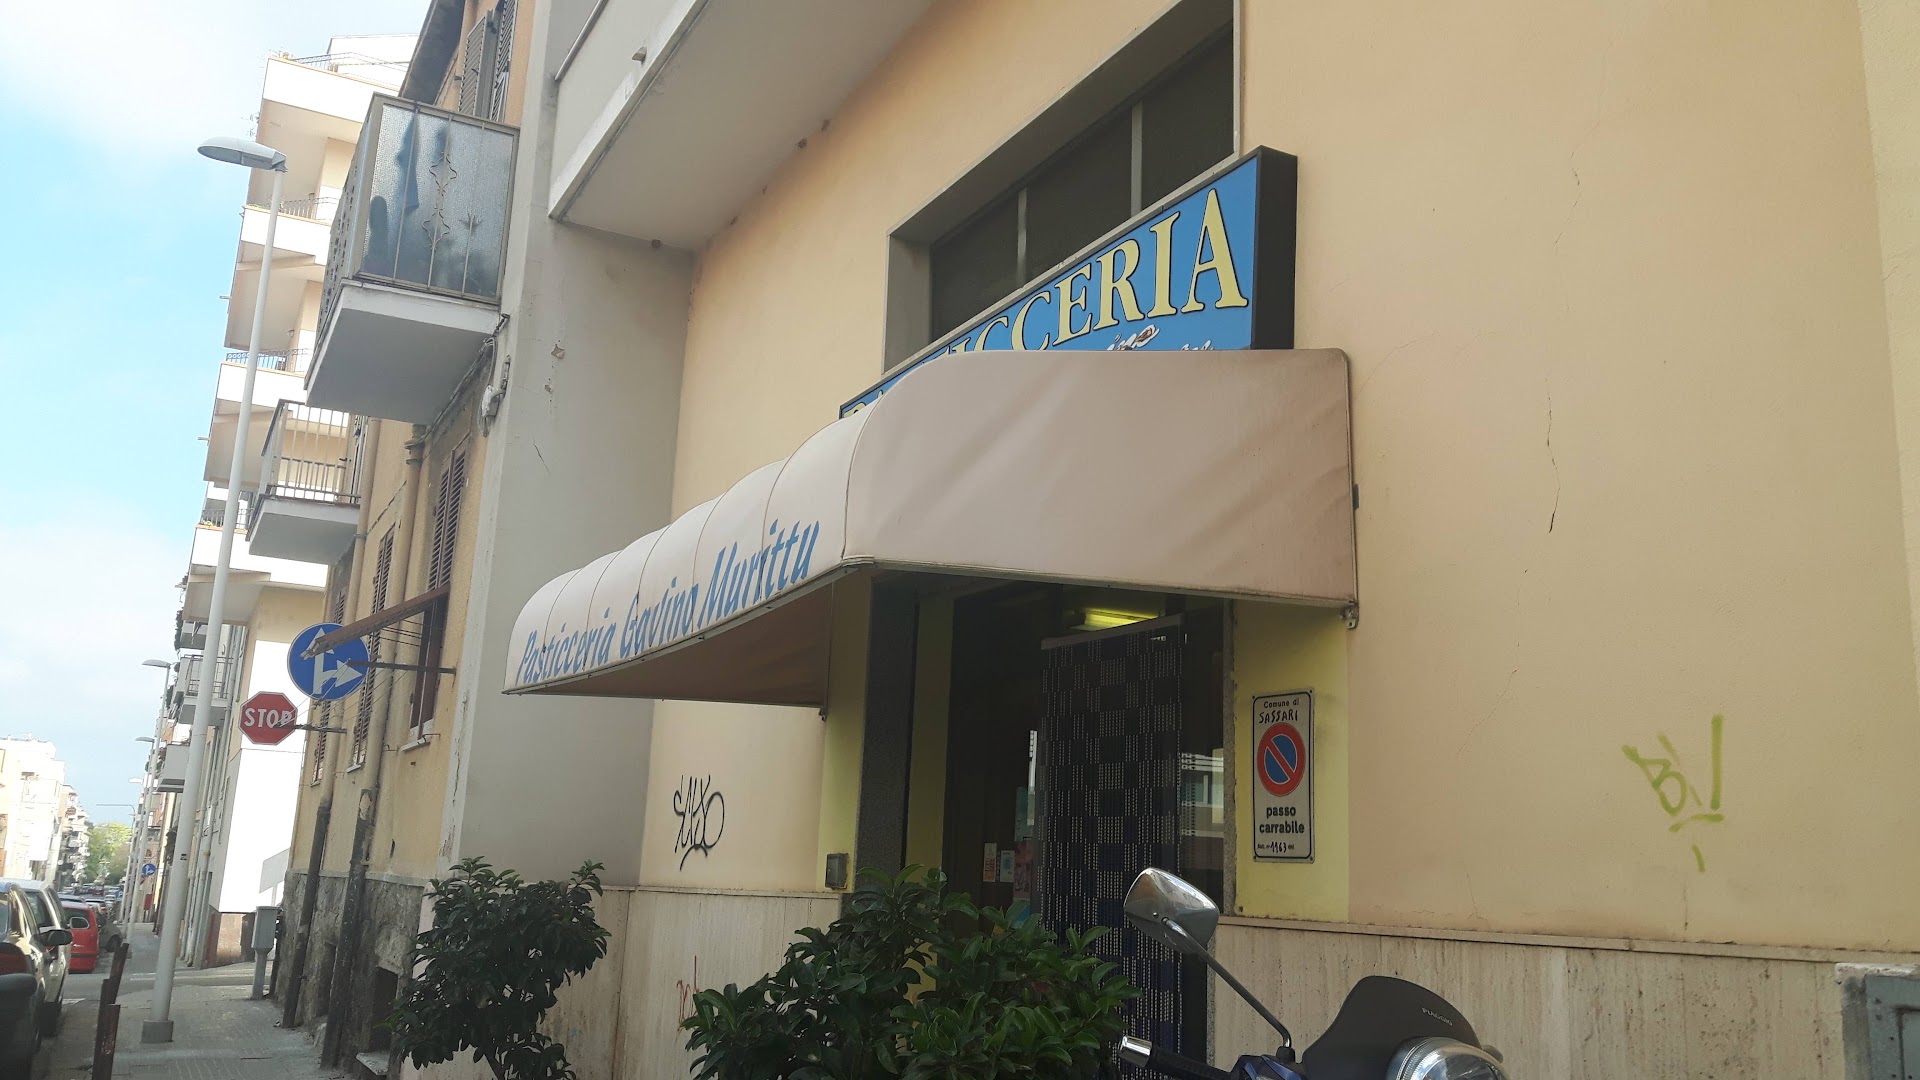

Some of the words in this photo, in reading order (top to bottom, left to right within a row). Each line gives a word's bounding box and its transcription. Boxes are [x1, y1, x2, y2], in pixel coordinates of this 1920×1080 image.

[514, 606, 617, 686] Pasticceria
[619, 576, 699, 660] Gavino
[697, 518, 819, 627] Murittu
[1263, 700, 1290, 709] Comune
[1292, 697, 1300, 706] di
[244, 707, 293, 729] STOP
[1258, 709, 1298, 724] SASSARI
[1266, 806, 1296, 819] passo
[1259, 821, 1305, 834] carrabile
[1270, 841, 1287, 854] 1163
